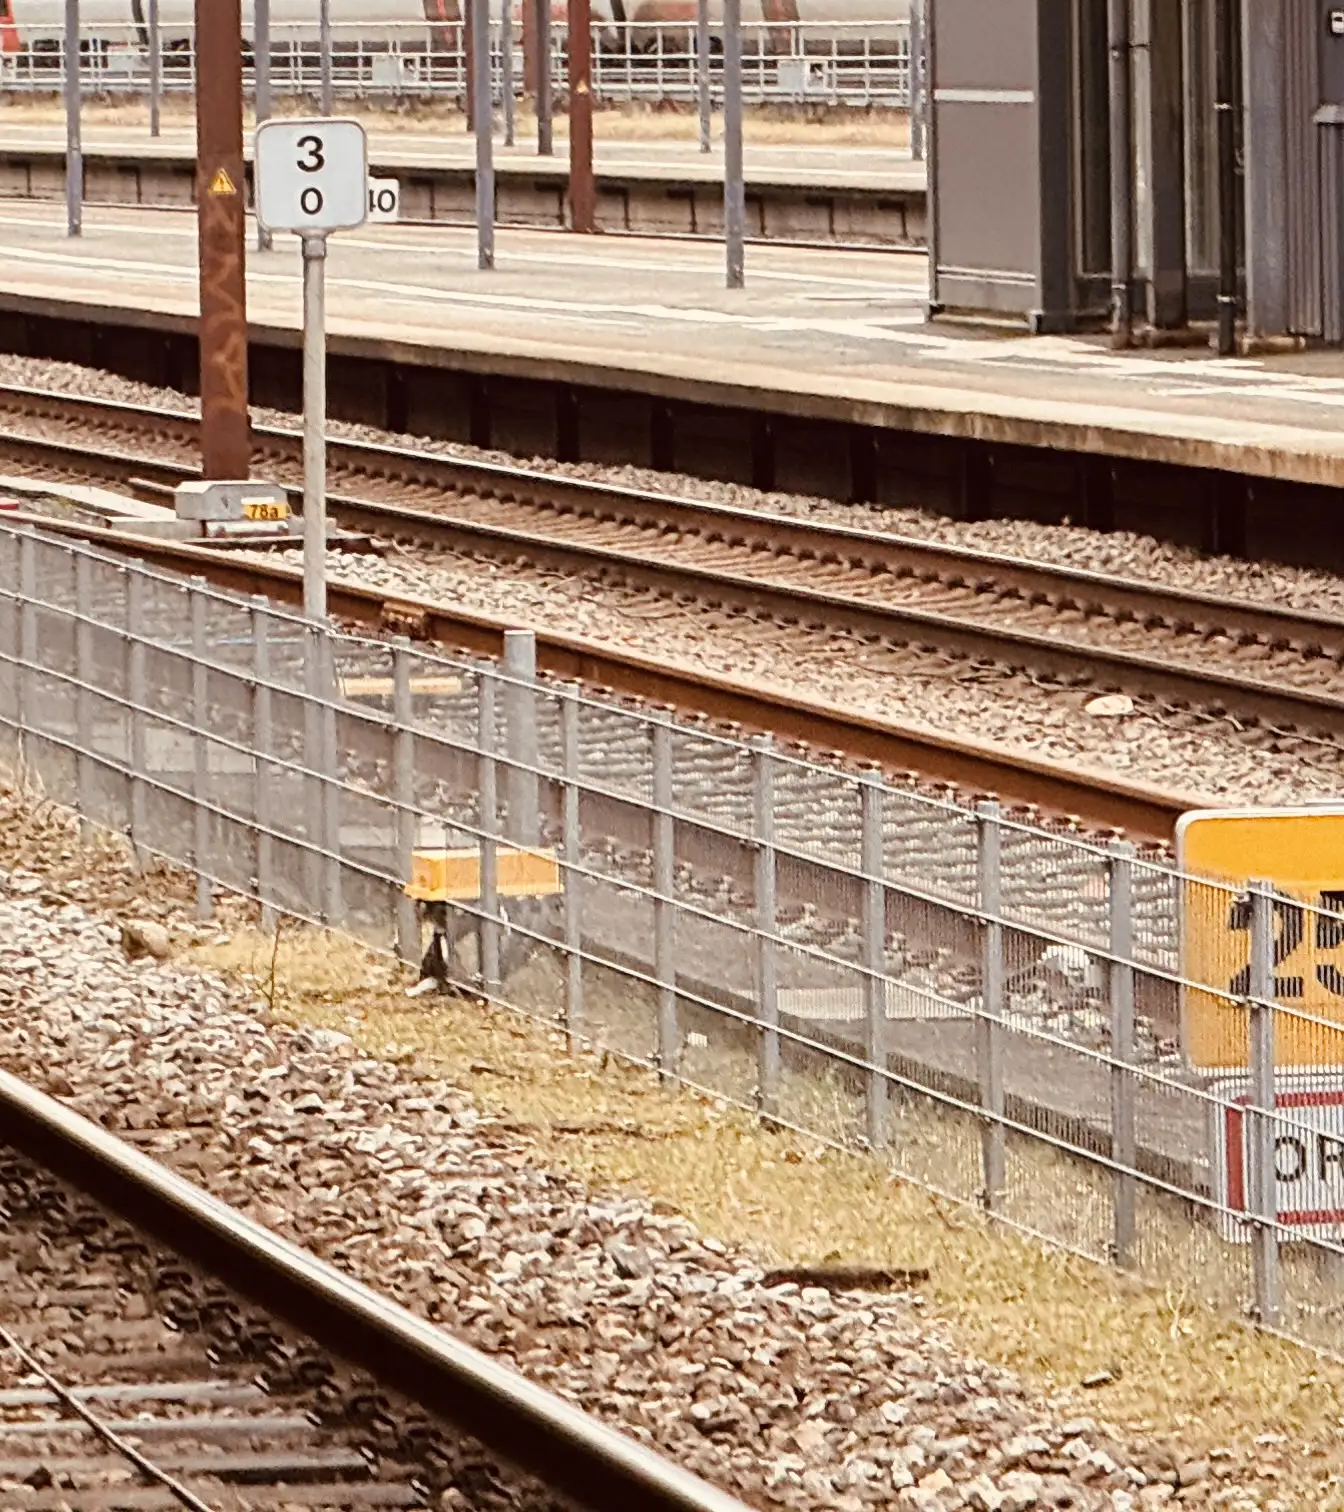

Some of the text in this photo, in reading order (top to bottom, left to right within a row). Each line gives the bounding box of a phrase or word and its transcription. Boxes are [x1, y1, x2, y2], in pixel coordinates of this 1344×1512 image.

[296, 135, 325, 173] 3
[300, 187, 324, 215] 0
[249, 503, 279, 519] 78a
